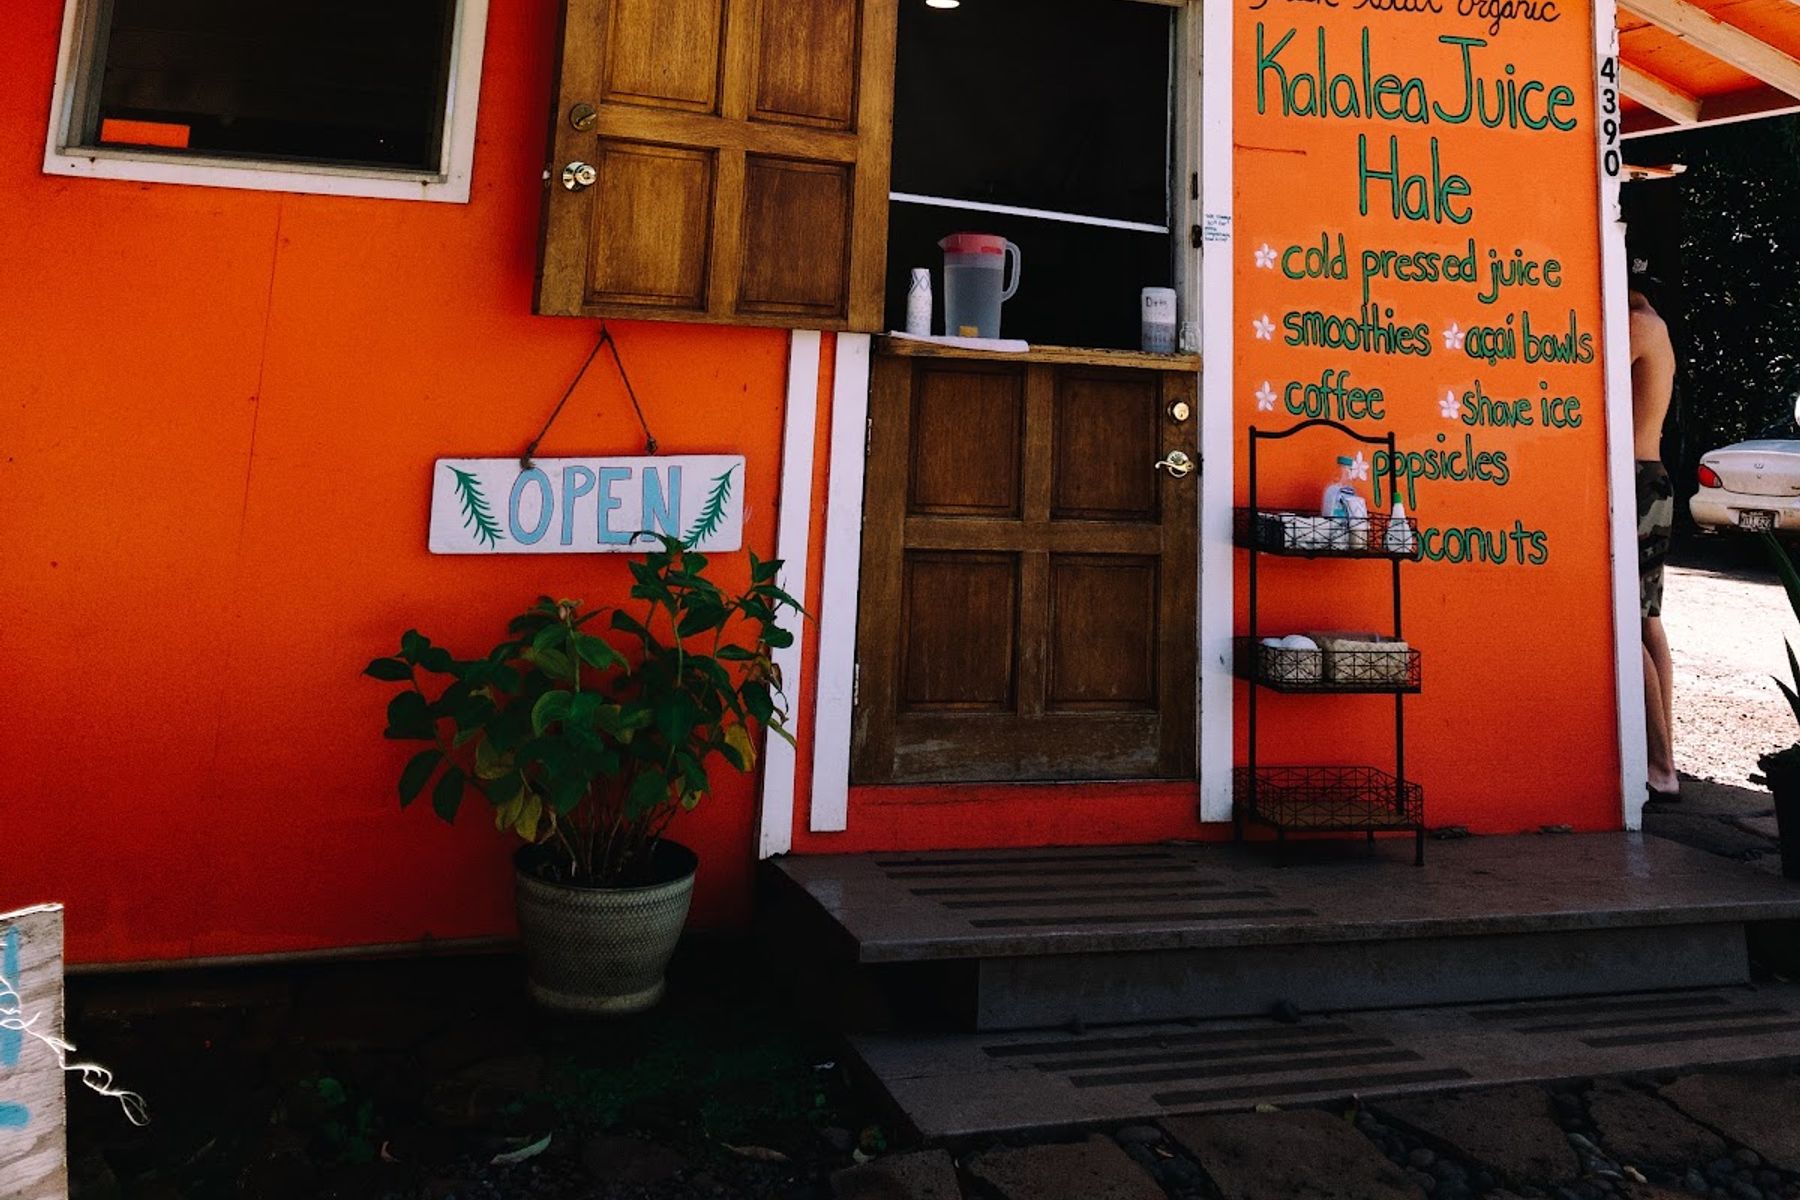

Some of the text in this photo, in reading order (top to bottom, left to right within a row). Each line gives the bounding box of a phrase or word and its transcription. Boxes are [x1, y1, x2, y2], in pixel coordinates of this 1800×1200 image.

[1256, 21, 1578, 131] Kalalea Juice
[1600, 57, 1620, 177] 4390
[1358, 133, 1473, 224] Hale
[1281, 232, 1562, 304] cold pressed juice
[1283, 303, 1432, 356] smoothies
[1522, 309, 1595, 364] bowls
[1284, 369, 1386, 420] coffee
[1461, 379, 1583, 428] shave ice
[508, 465, 683, 546] OPEN
[1372, 434, 1510, 511] popsicles
